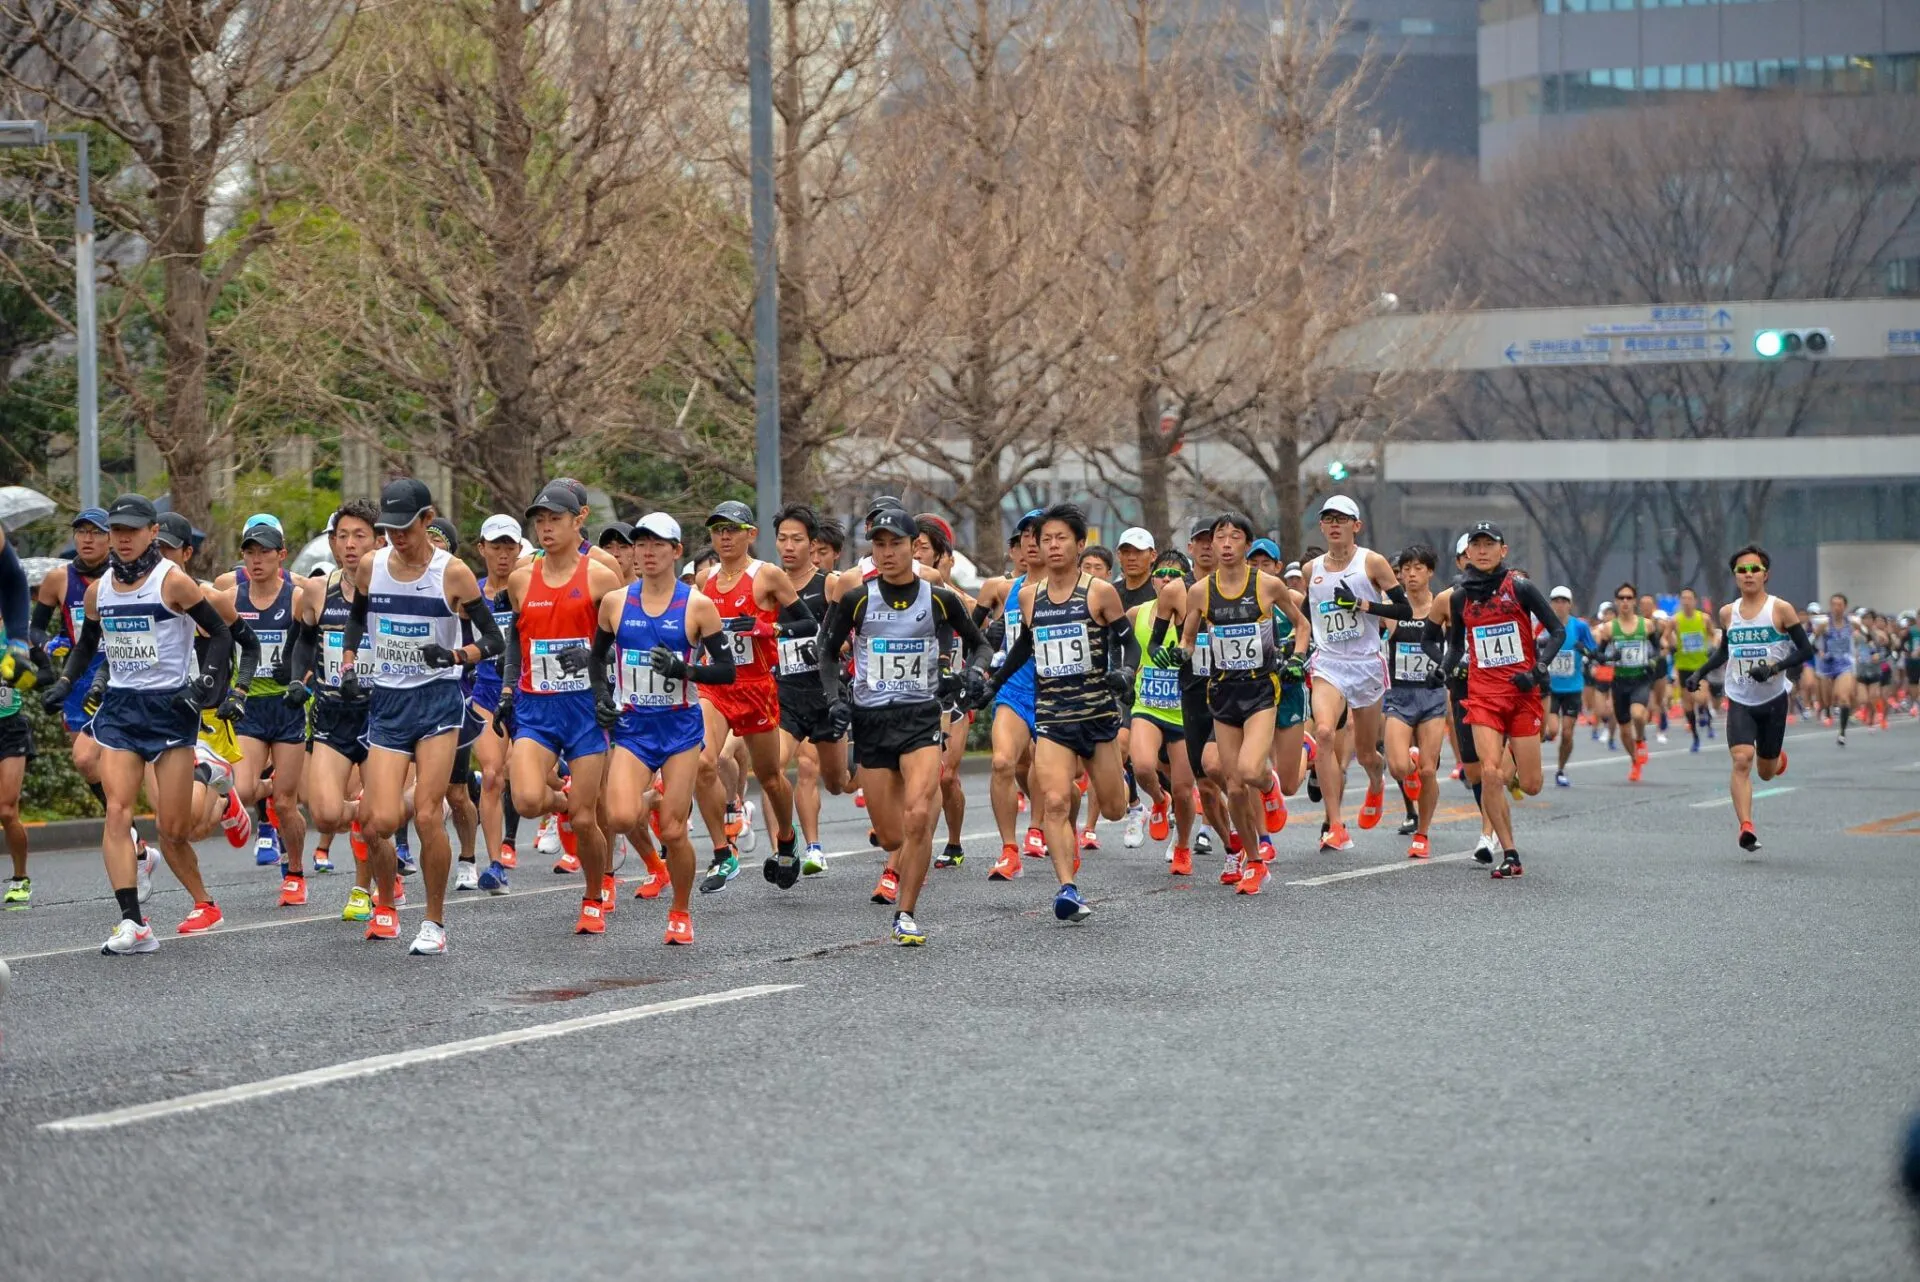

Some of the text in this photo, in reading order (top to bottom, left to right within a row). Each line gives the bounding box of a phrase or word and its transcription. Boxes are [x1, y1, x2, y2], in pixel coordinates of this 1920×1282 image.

[870, 612, 897, 621] JFE
[392, 625, 428, 634] 東京メトロ
[1050, 626, 1081, 638] 東京メトロ
[1398, 620, 1425, 629] GMO
[115, 636, 131, 645] PACE
[387, 639, 410, 650] PACE
[888, 643, 923, 651] 東京メトロ
[1481, 635, 1514, 659] 141
[1043, 639, 1086, 666] 119
[1219, 637, 1257, 660] 136
[879, 655, 922, 680] 154
[1403, 655, 1434, 673] 126
[632, 667, 676, 694] 116
[1140, 679, 1178, 697] A4504
